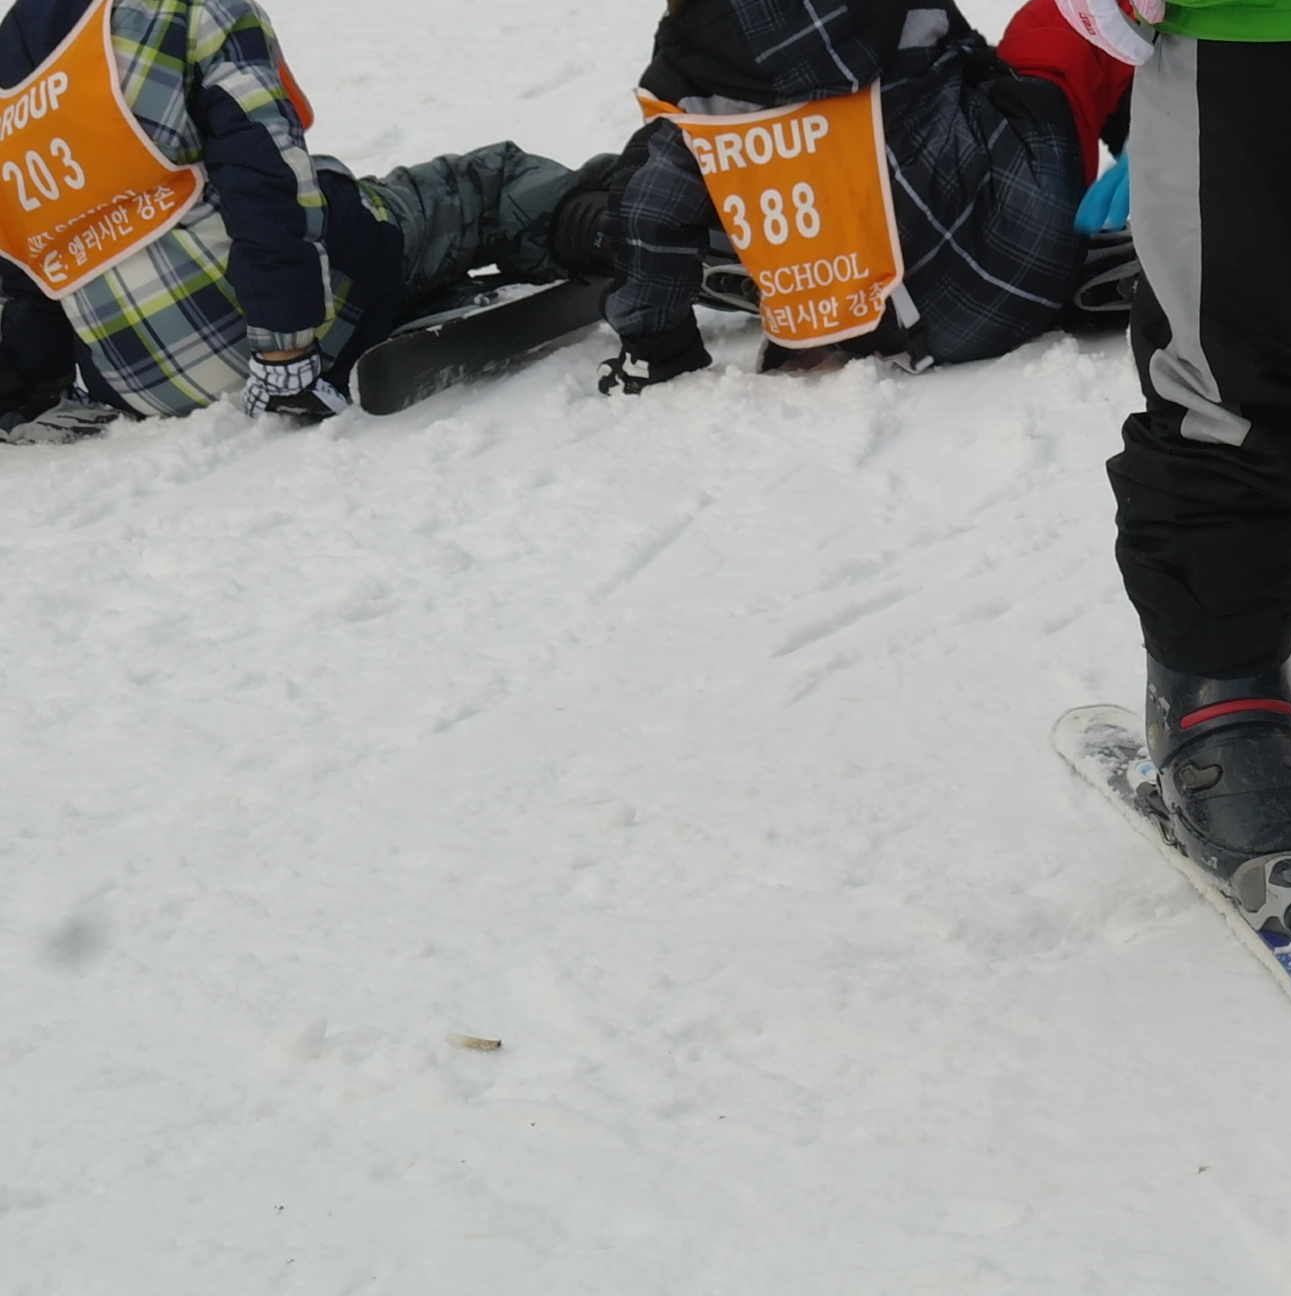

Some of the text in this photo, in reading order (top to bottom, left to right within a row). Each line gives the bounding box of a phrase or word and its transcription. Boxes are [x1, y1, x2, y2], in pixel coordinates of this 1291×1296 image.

[2, 137, 86, 212] 203
[691, 114, 829, 176] GROUP
[68, 204, 134, 267] 엘리시안
[722, 181, 821, 251] 388
[758, 252, 869, 298] SCHOOL
